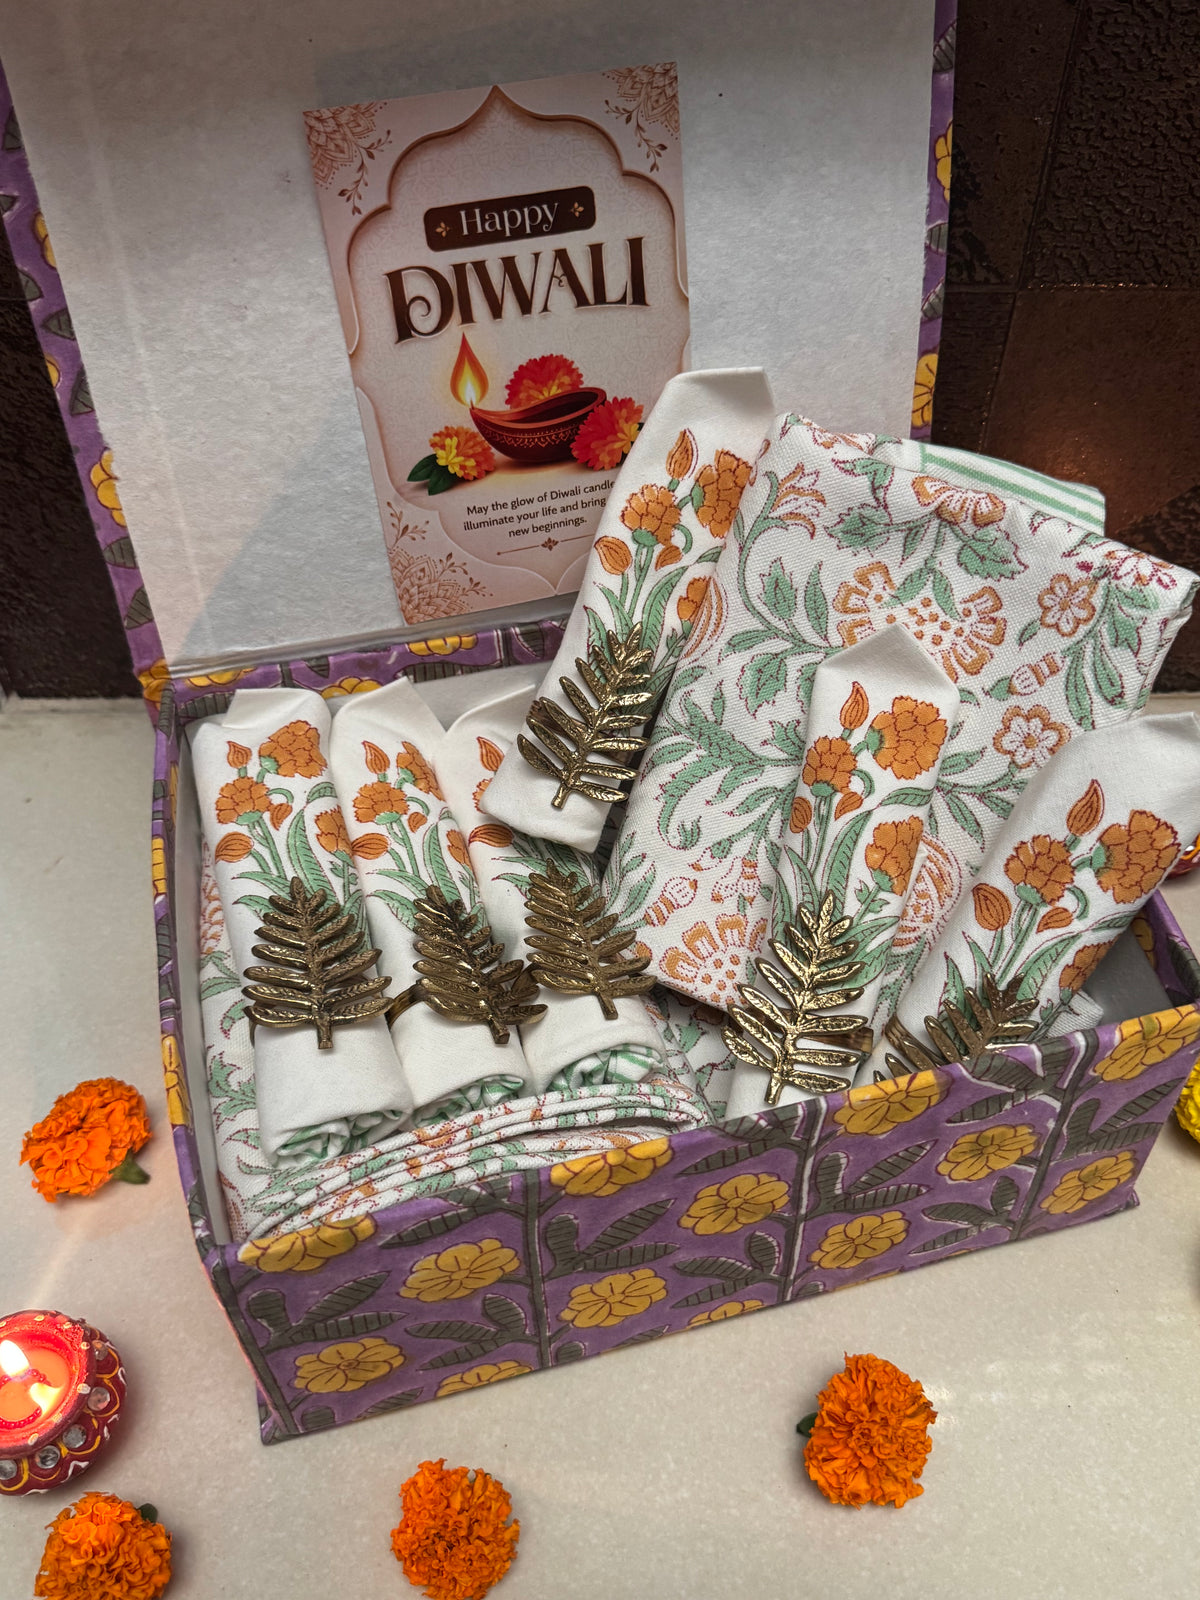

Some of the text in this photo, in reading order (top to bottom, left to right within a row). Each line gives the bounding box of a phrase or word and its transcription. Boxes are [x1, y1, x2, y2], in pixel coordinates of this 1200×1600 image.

[459, 202, 559, 237] Happy
[384, 236, 650, 345] DIWALI
[463, 497, 607, 531] illuminate your life and bring
[467, 505, 489, 516] May
[491, 499, 508, 512] the
[510, 495, 535, 511] glow
[537, 491, 548, 503] of
[550, 486, 581, 500] Diwali
[508, 516, 587, 538] new beginnings.
